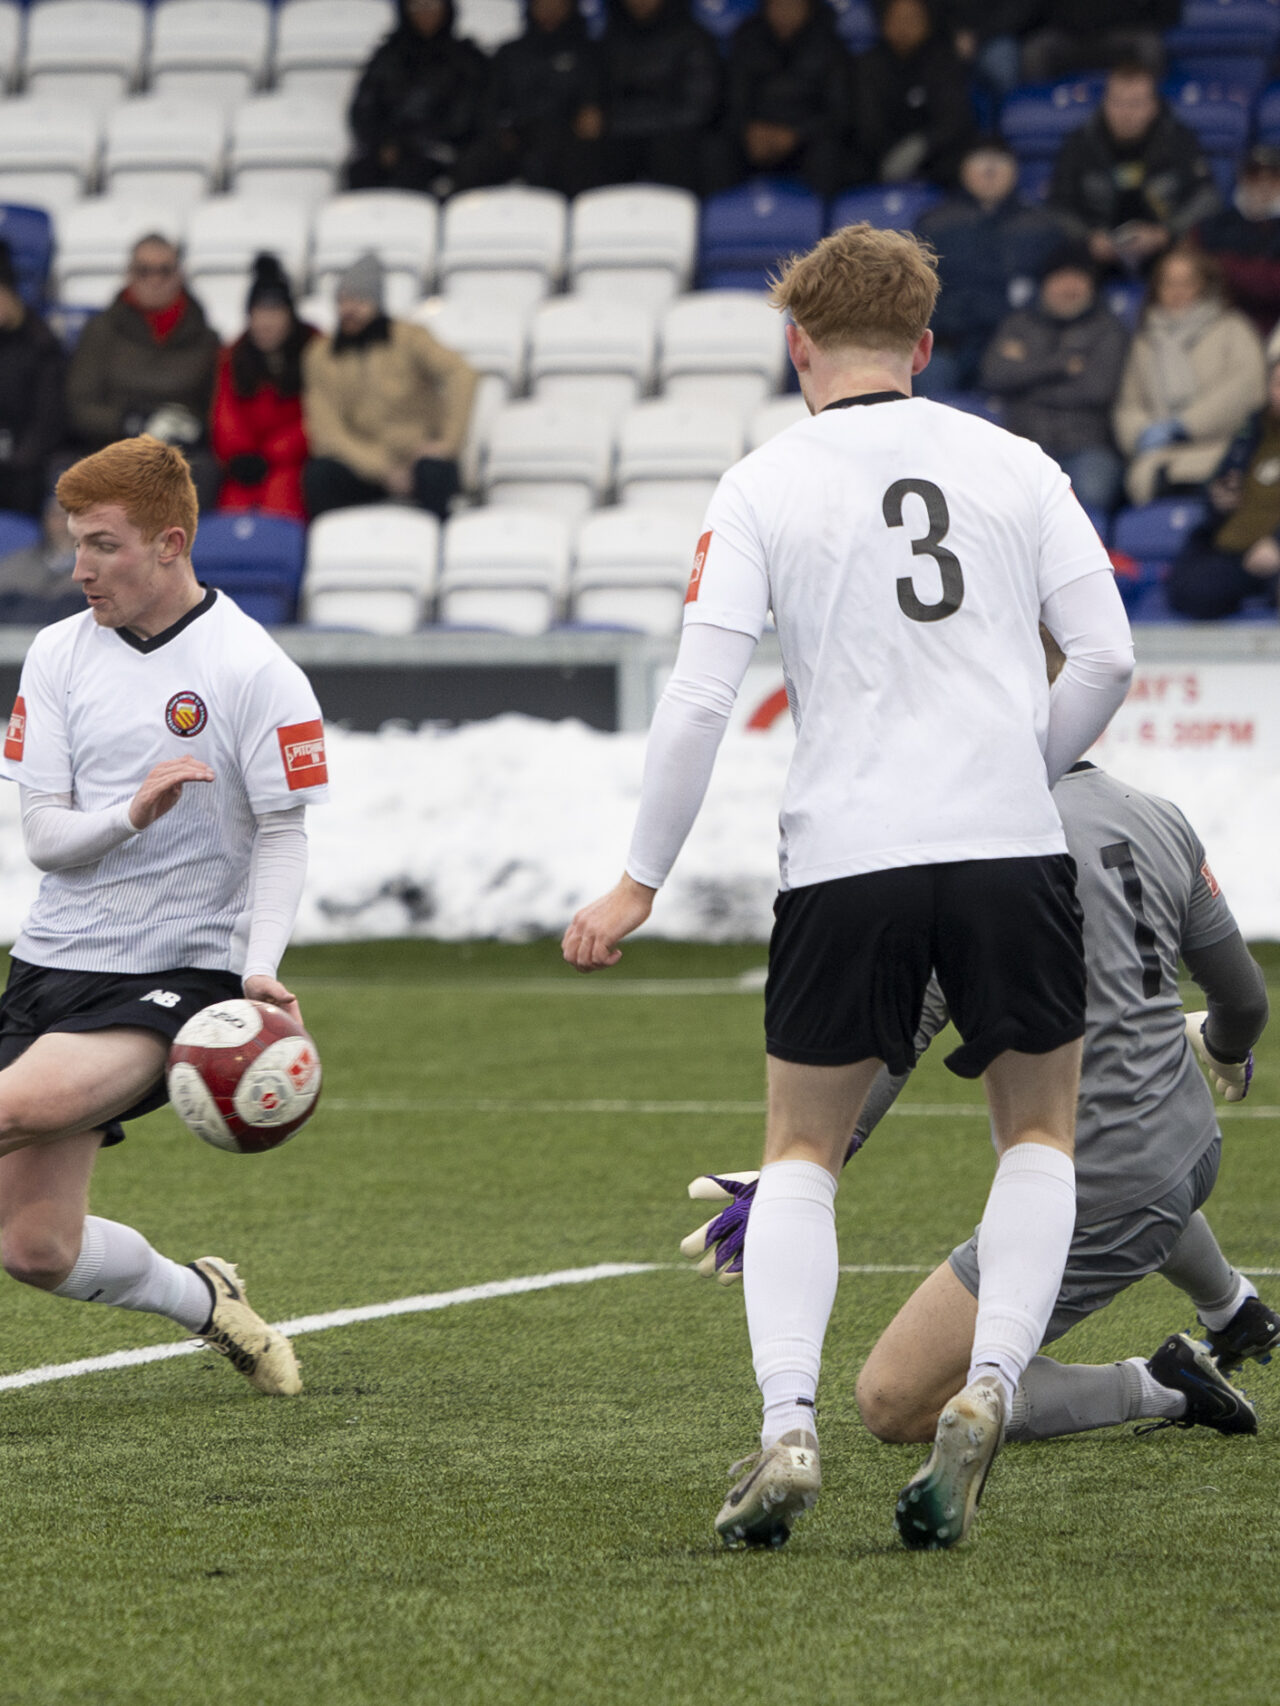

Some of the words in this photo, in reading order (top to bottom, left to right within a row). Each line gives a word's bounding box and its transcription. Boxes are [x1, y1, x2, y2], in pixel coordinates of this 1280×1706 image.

[882, 478, 964, 622] 3
[1127, 674, 1198, 702] AY'S
[1100, 841, 1162, 1000] 1
